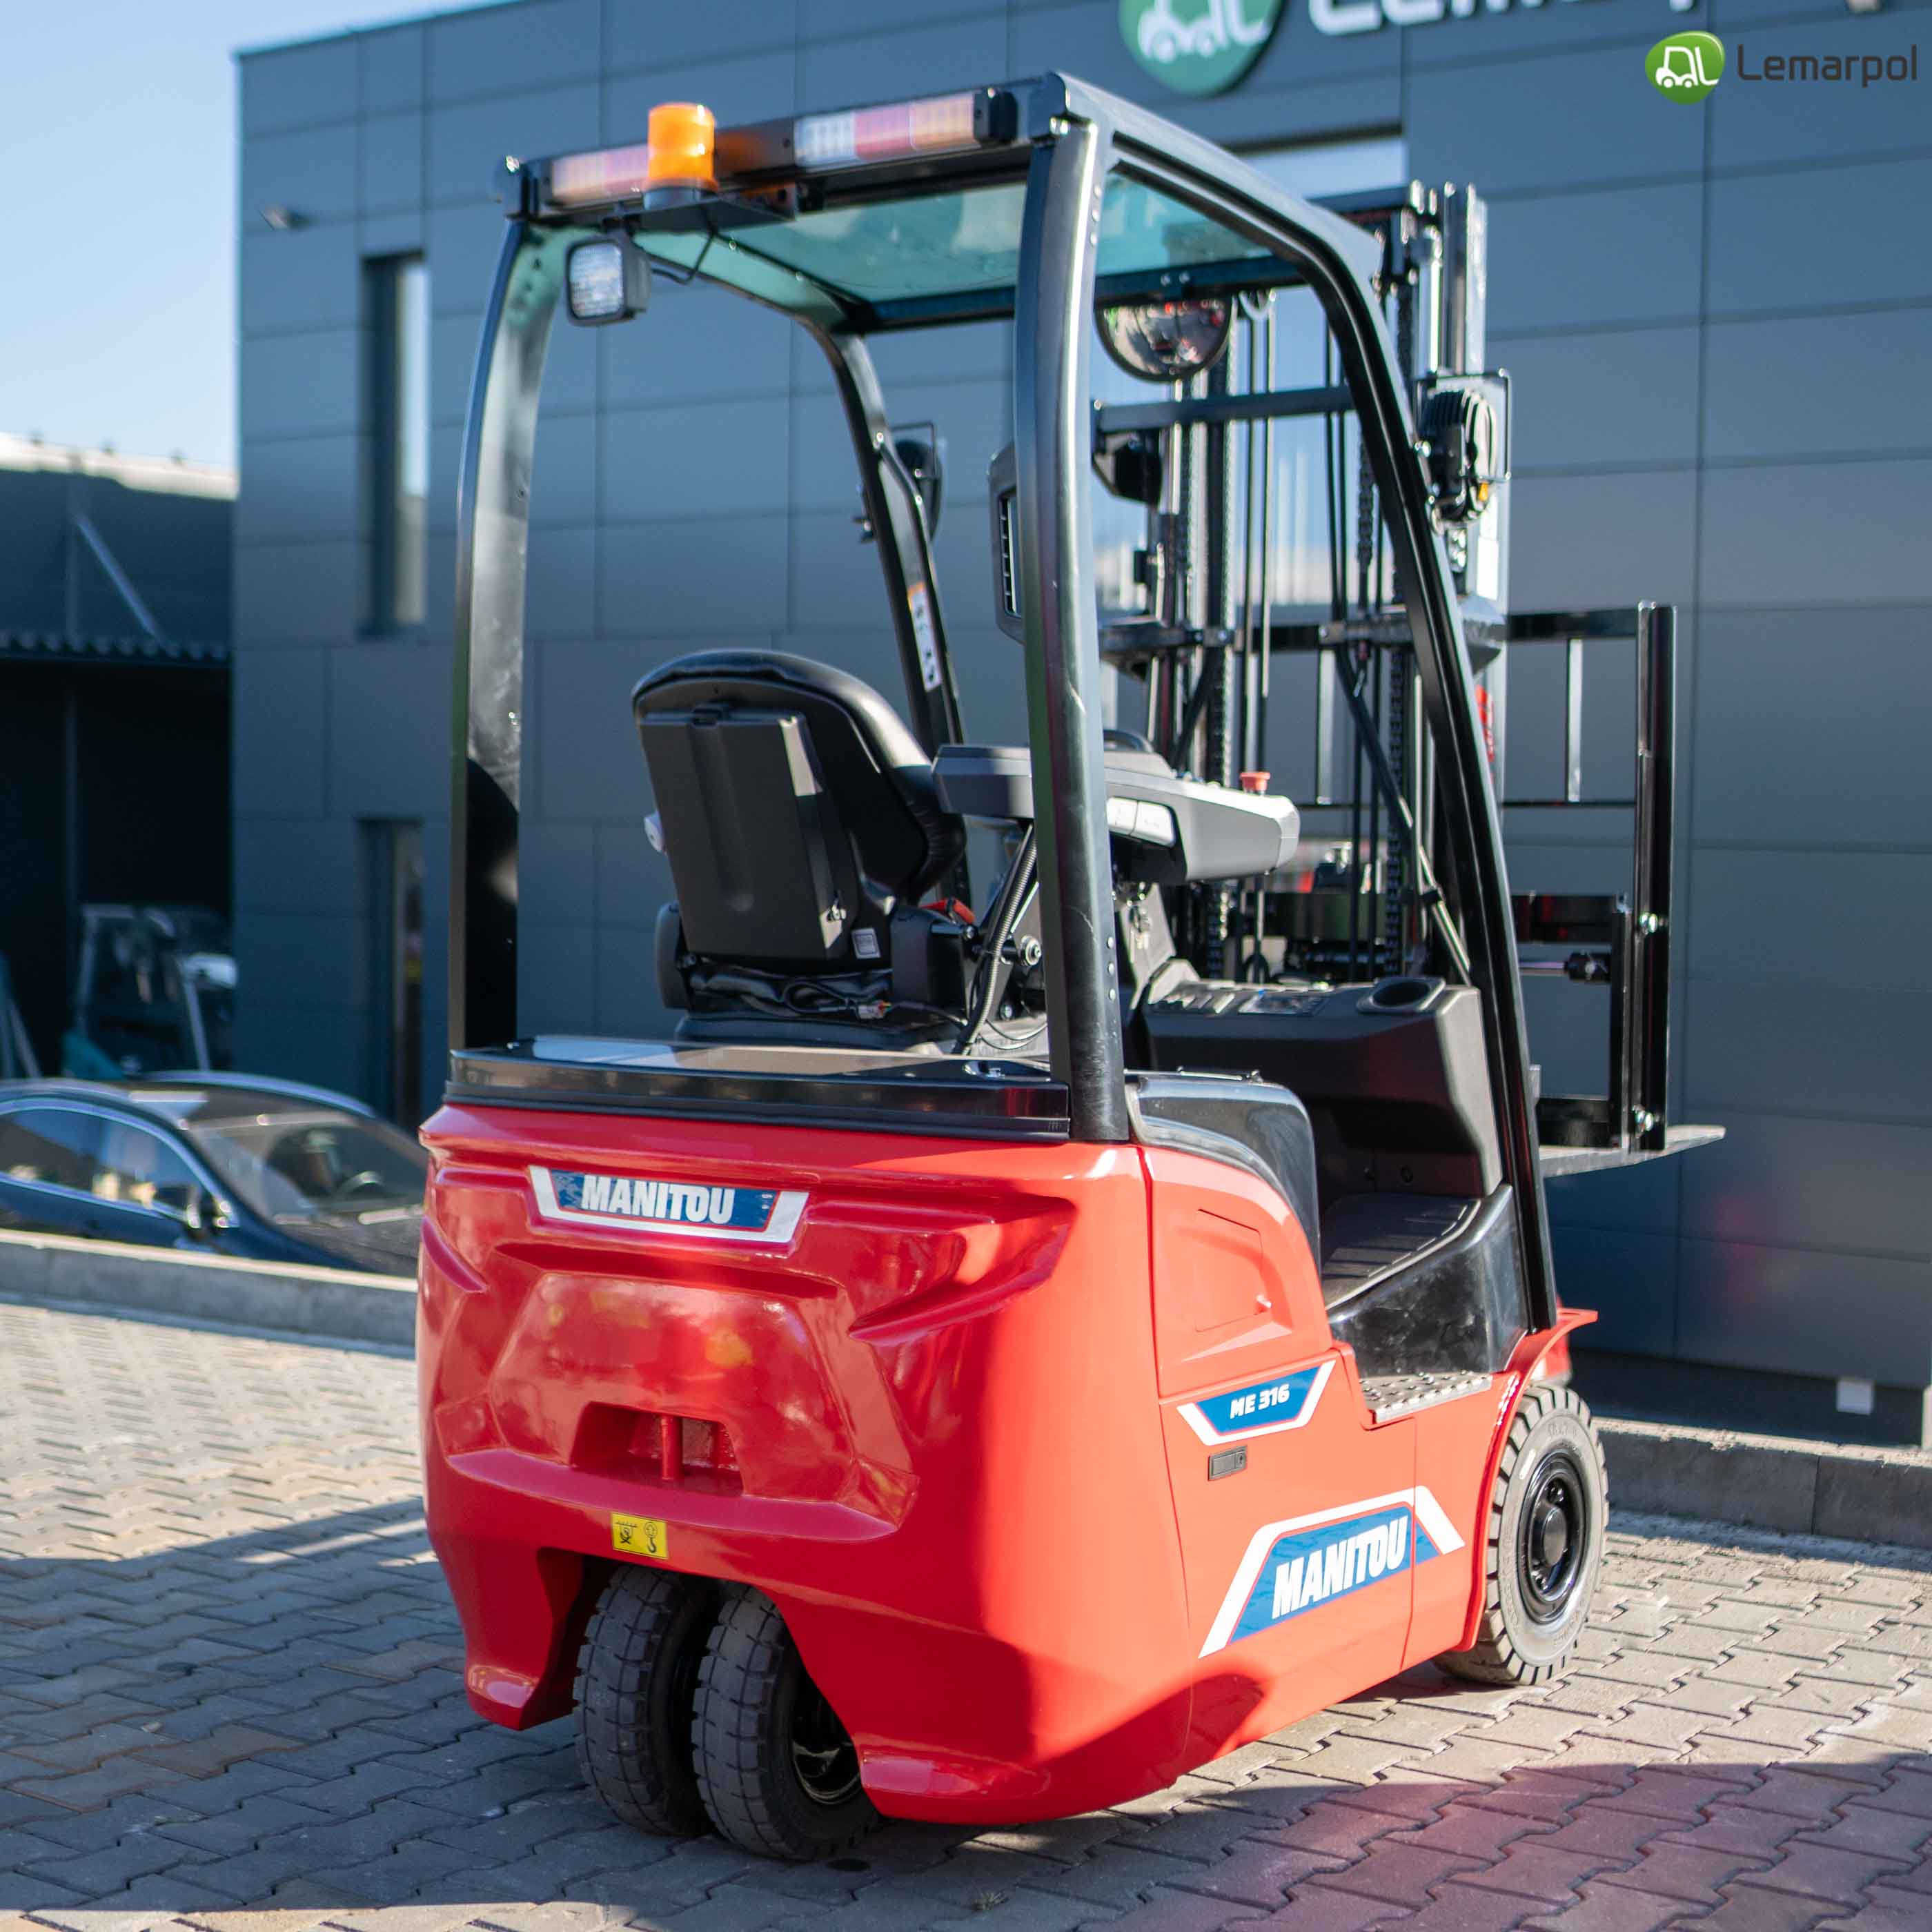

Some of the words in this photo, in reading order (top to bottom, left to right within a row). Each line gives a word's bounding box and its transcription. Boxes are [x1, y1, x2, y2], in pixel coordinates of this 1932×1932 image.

[580, 1174, 736, 1224] MANITOU
[1230, 1393, 1256, 1419] ME
[1258, 1383, 1290, 1410] 316
[1272, 1515, 1408, 1619] MANITOU
